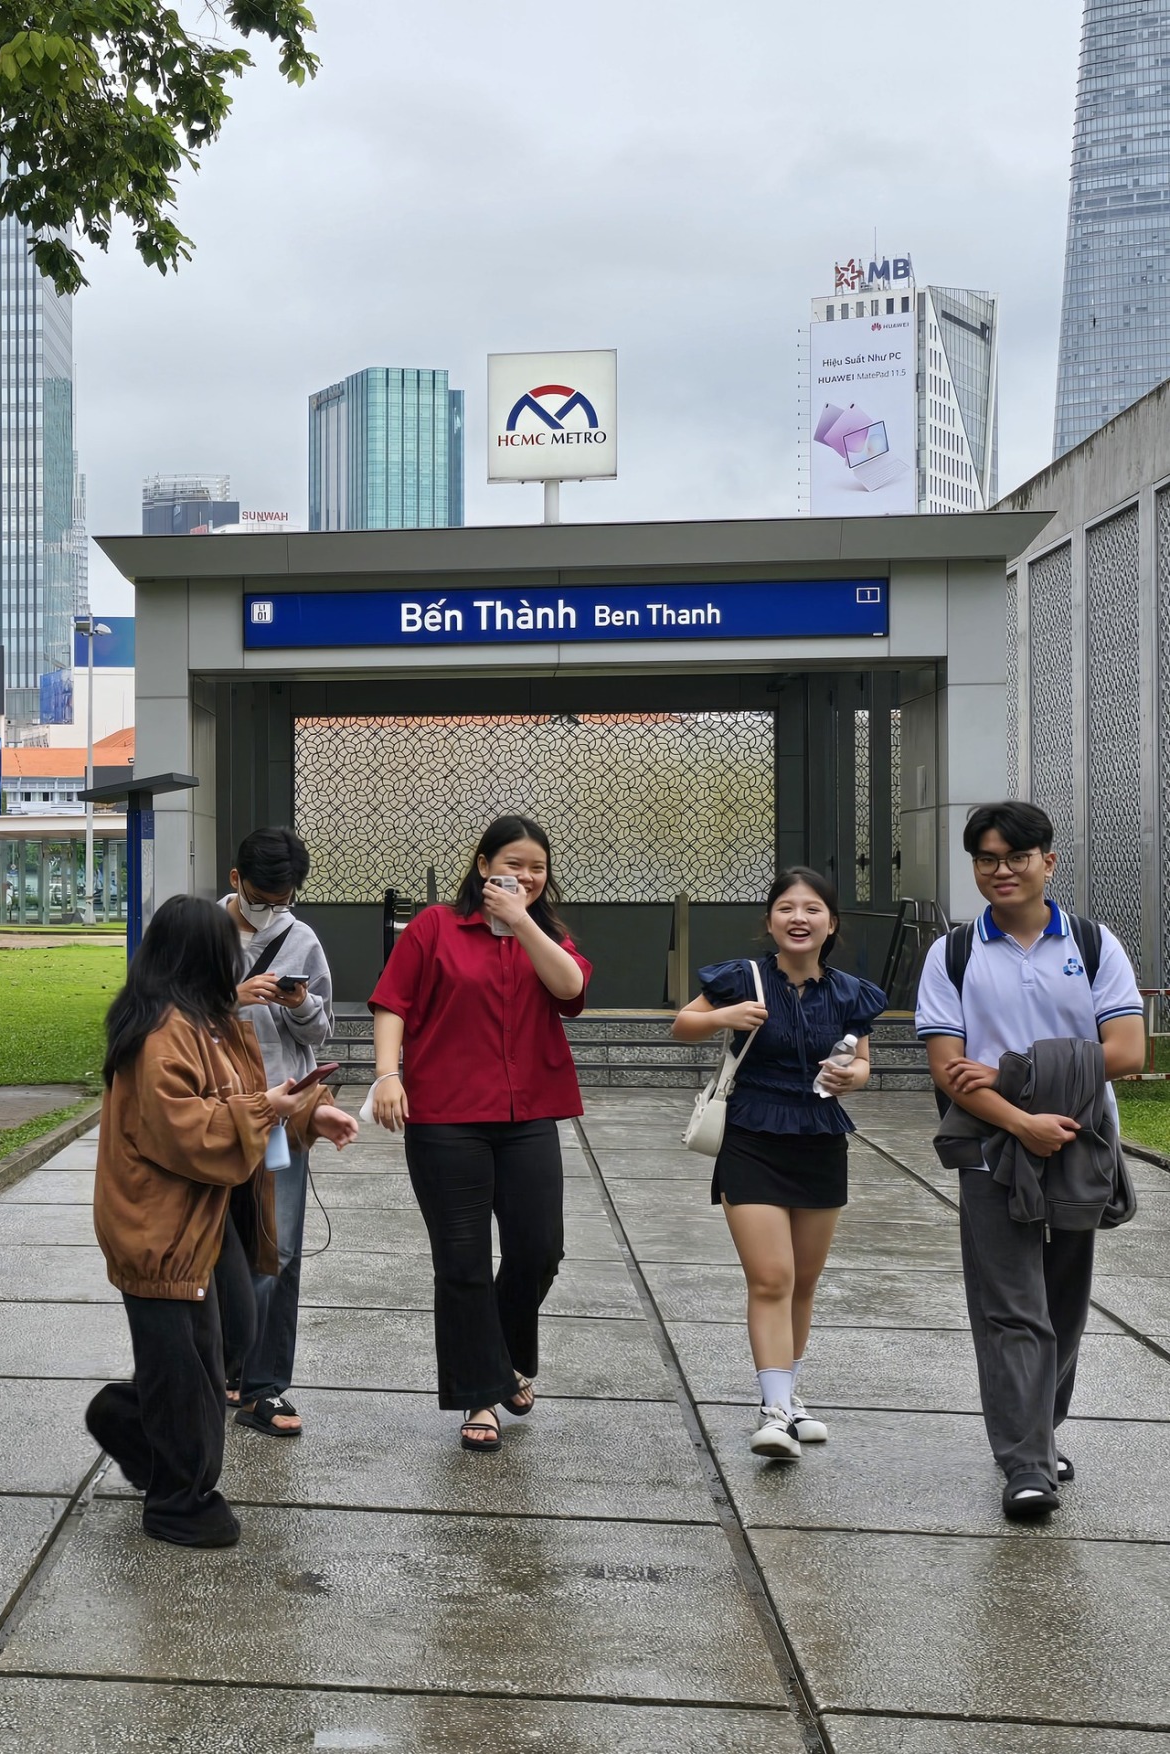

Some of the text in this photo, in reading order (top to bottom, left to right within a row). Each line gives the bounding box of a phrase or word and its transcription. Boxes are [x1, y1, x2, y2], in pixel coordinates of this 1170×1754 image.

[868, 258, 910, 283] MB
[822, 351, 902, 368] Hiệu Suất Như PC
[818, 368, 907, 384] HUAWEI MatePad 11.5
[497, 430, 607, 447] HCMC METRO
[241, 511, 289, 521] SUNWAH
[400, 598, 721, 633] Bến Thành Ben Thanh
